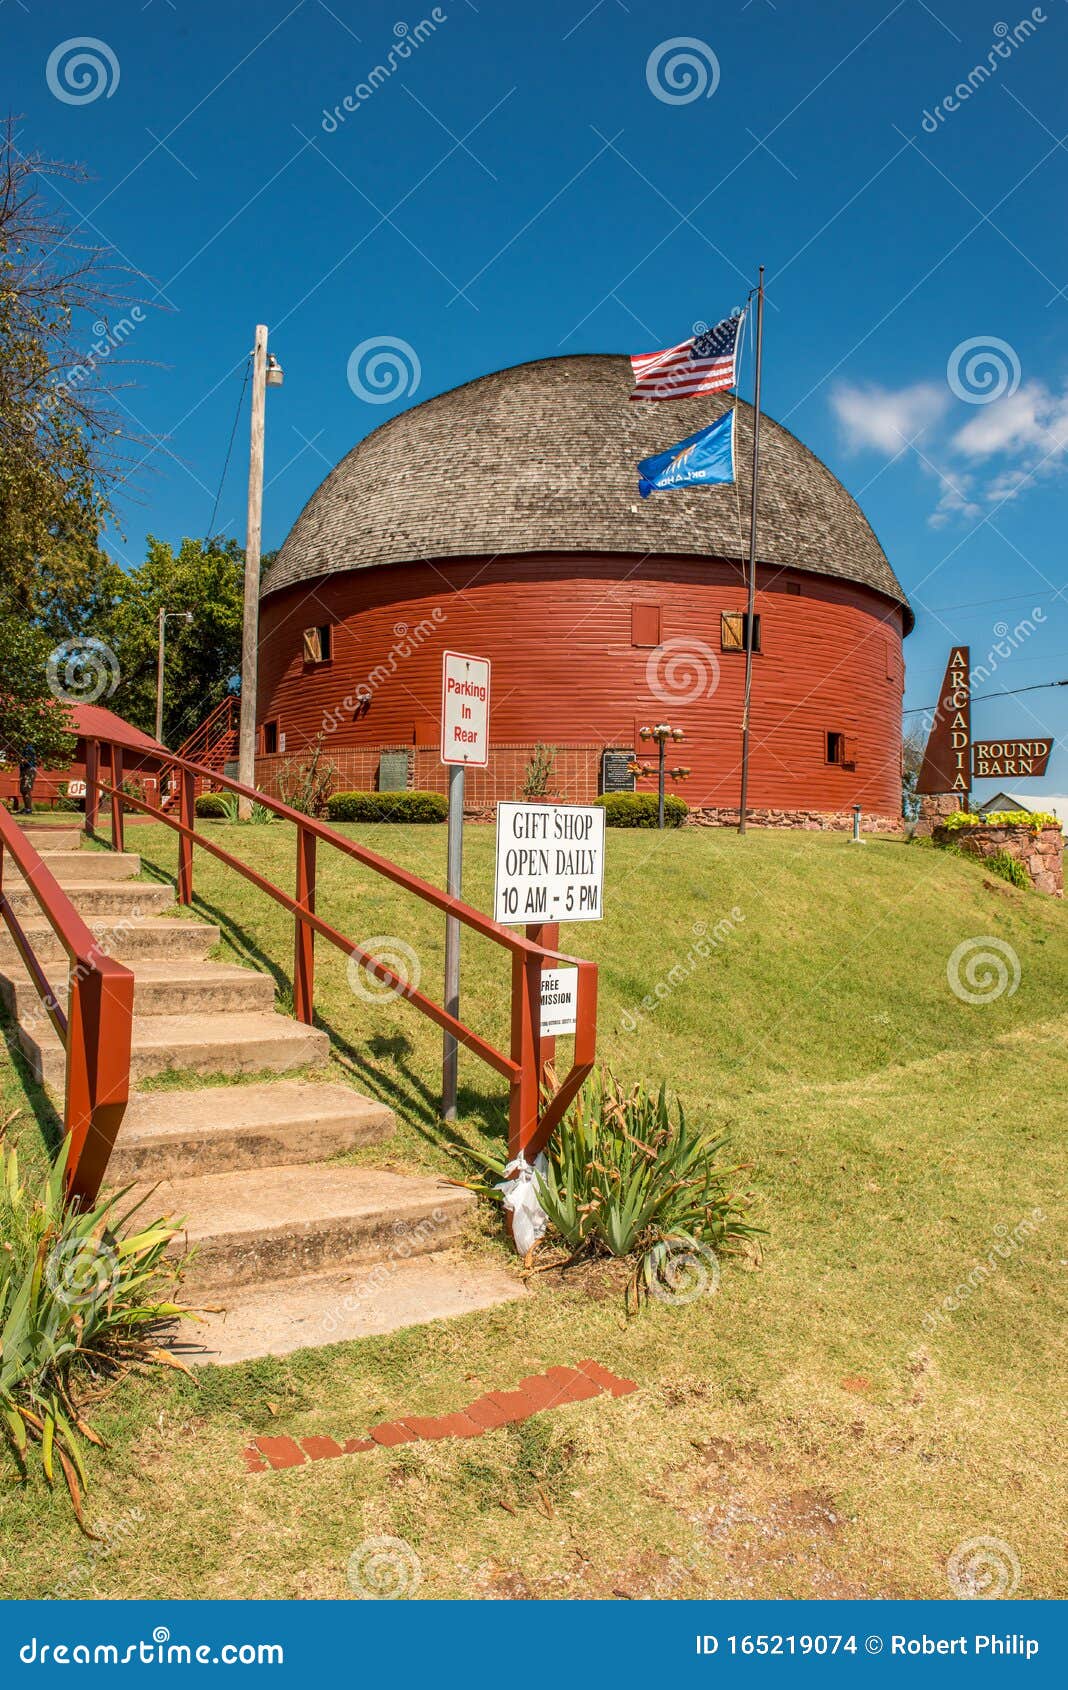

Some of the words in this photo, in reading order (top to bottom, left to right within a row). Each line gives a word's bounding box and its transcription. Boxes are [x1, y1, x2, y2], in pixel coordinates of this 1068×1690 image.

[447, 677, 486, 702] Parking
[461, 703, 472, 720] In
[950, 650, 968, 790] ARCADIA
[454, 726, 478, 744] Rear
[976, 742, 1048, 760] ROUND
[977, 760, 1034, 776] BARN
[513, 811, 550, 839] GIFT
[554, 813, 593, 840] SHOP
[505, 849, 550, 877] OPEN
[555, 849, 597, 876] DAILY
[502, 886, 519, 914] 10
[524, 886, 547, 914] AM
[566, 885, 575, 912] 5
[579, 885, 598, 911] PM
[541, 980, 560, 992] FREE
